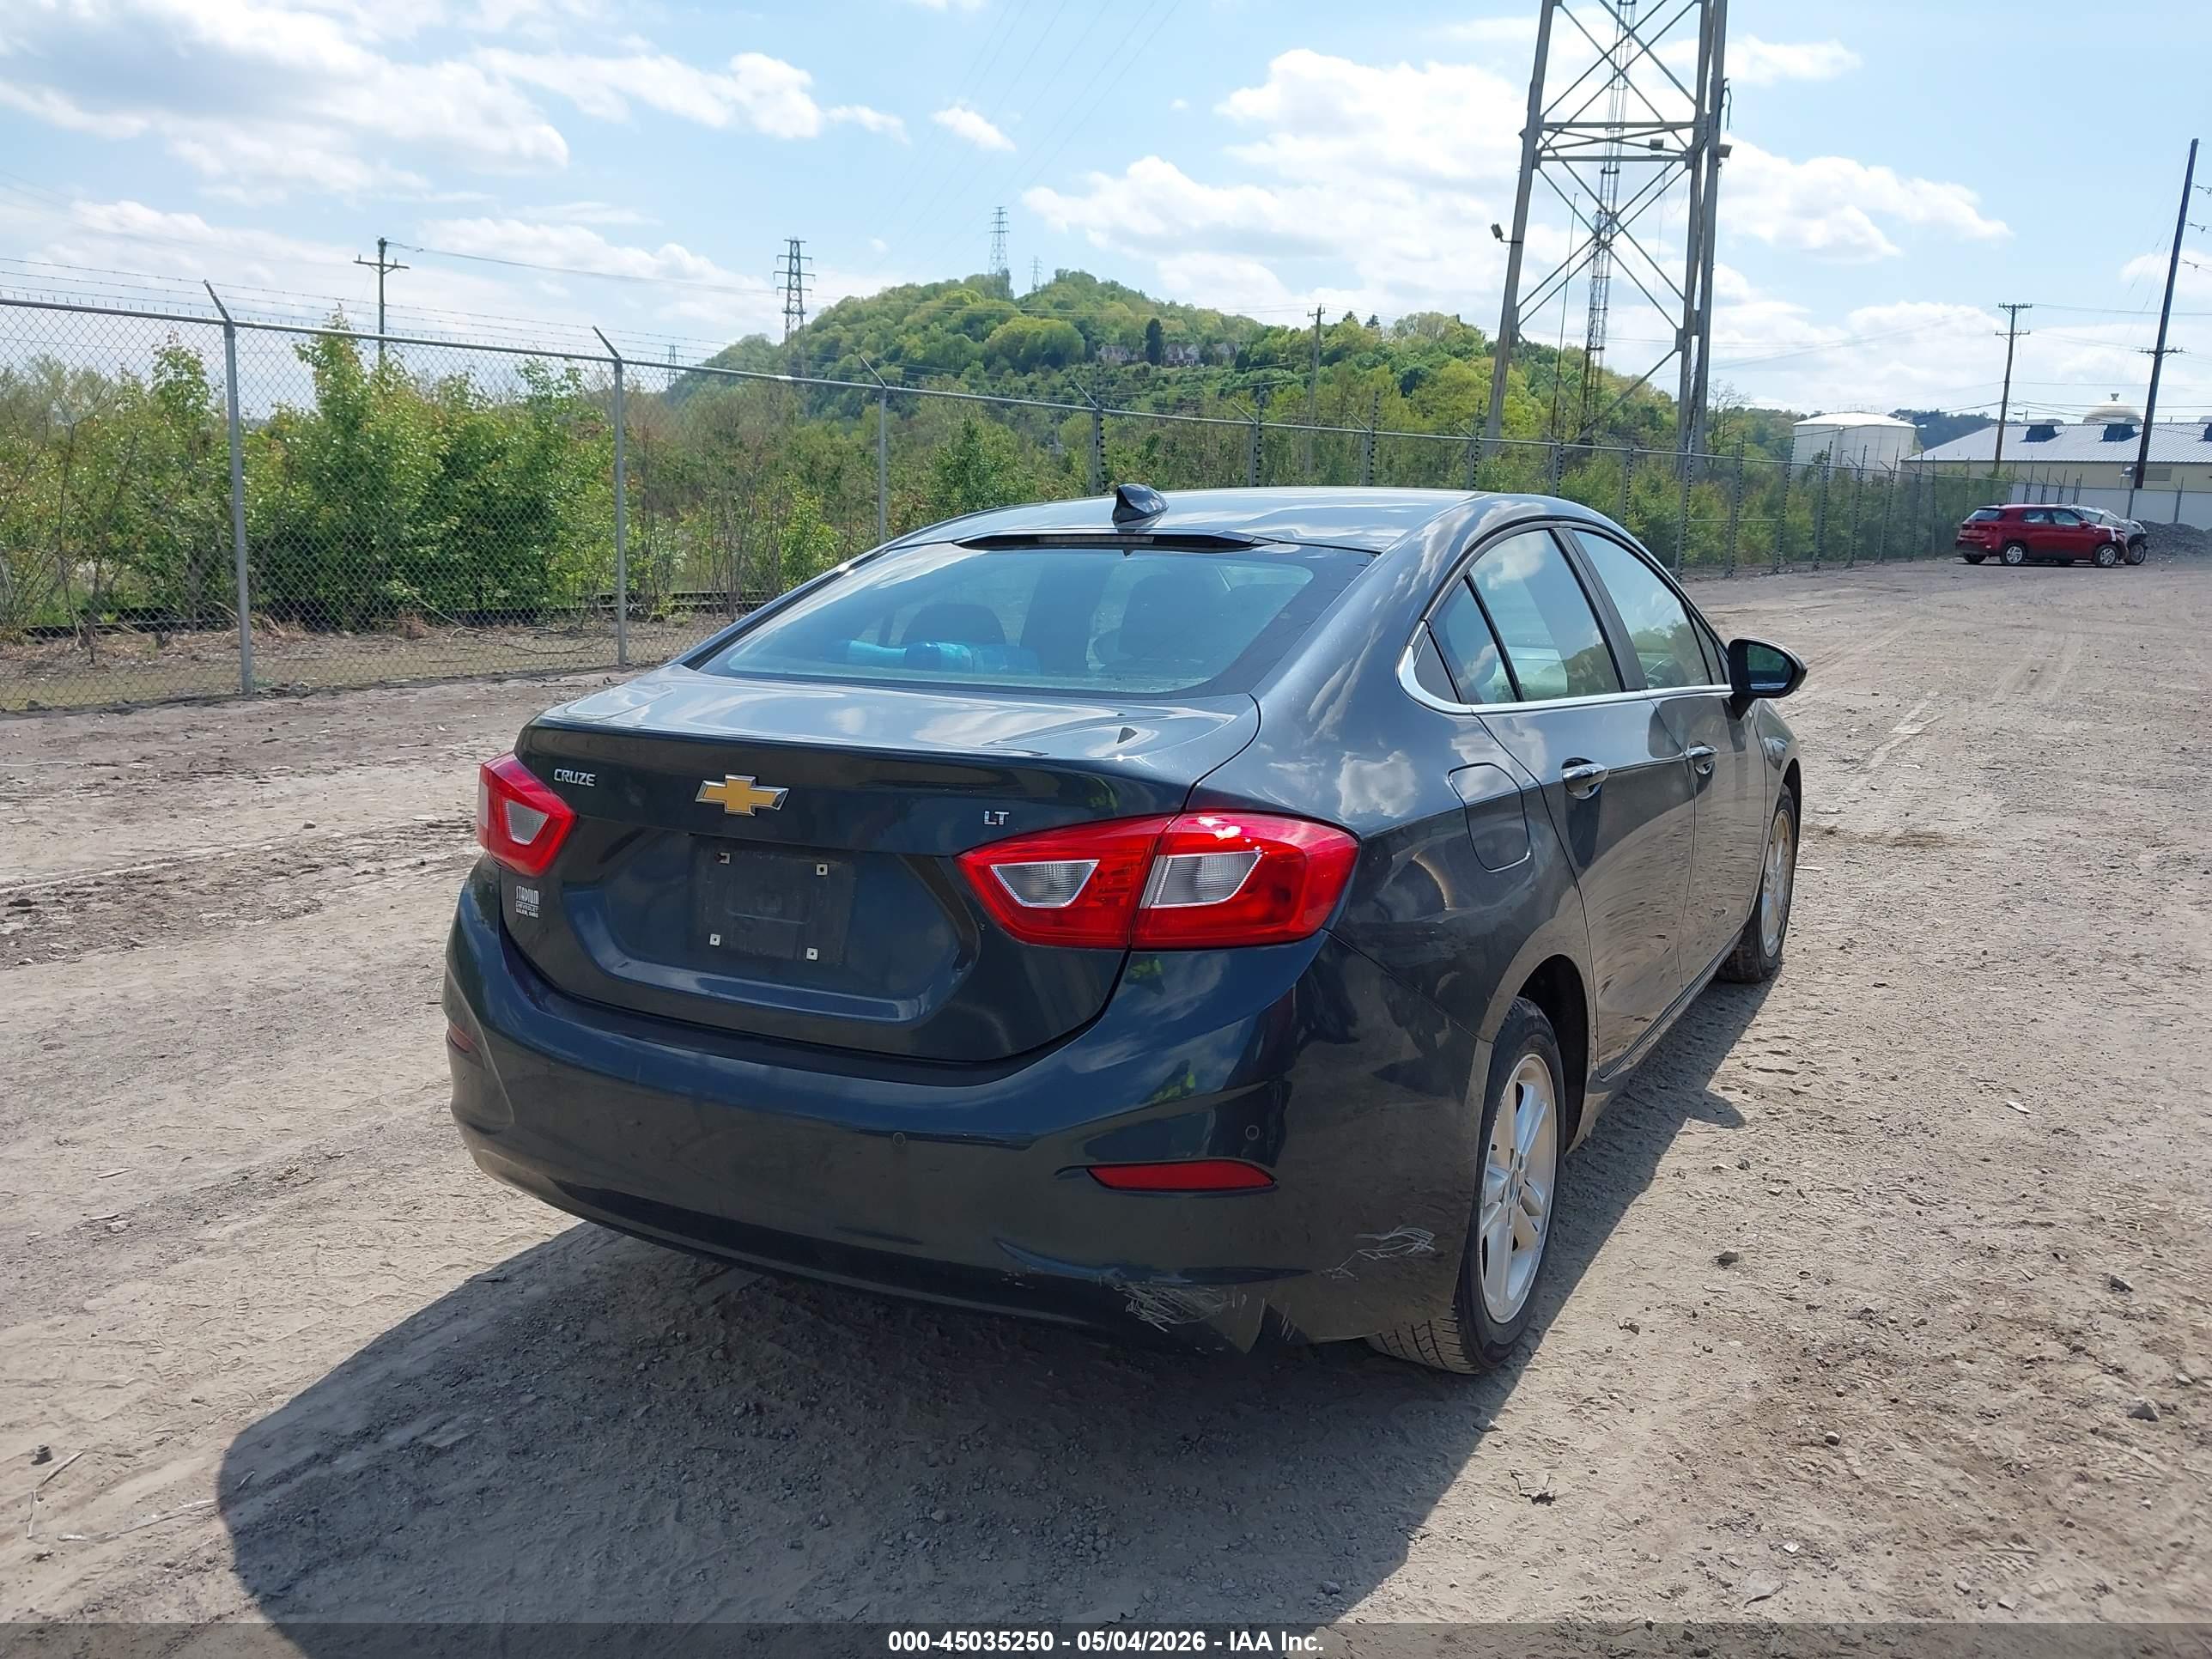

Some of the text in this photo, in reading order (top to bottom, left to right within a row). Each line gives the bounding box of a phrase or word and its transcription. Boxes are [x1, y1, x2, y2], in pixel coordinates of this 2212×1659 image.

[554, 769, 596, 787] CRUZE
[984, 811, 1010, 825] LT
[515, 885, 539, 905] STADIUM
